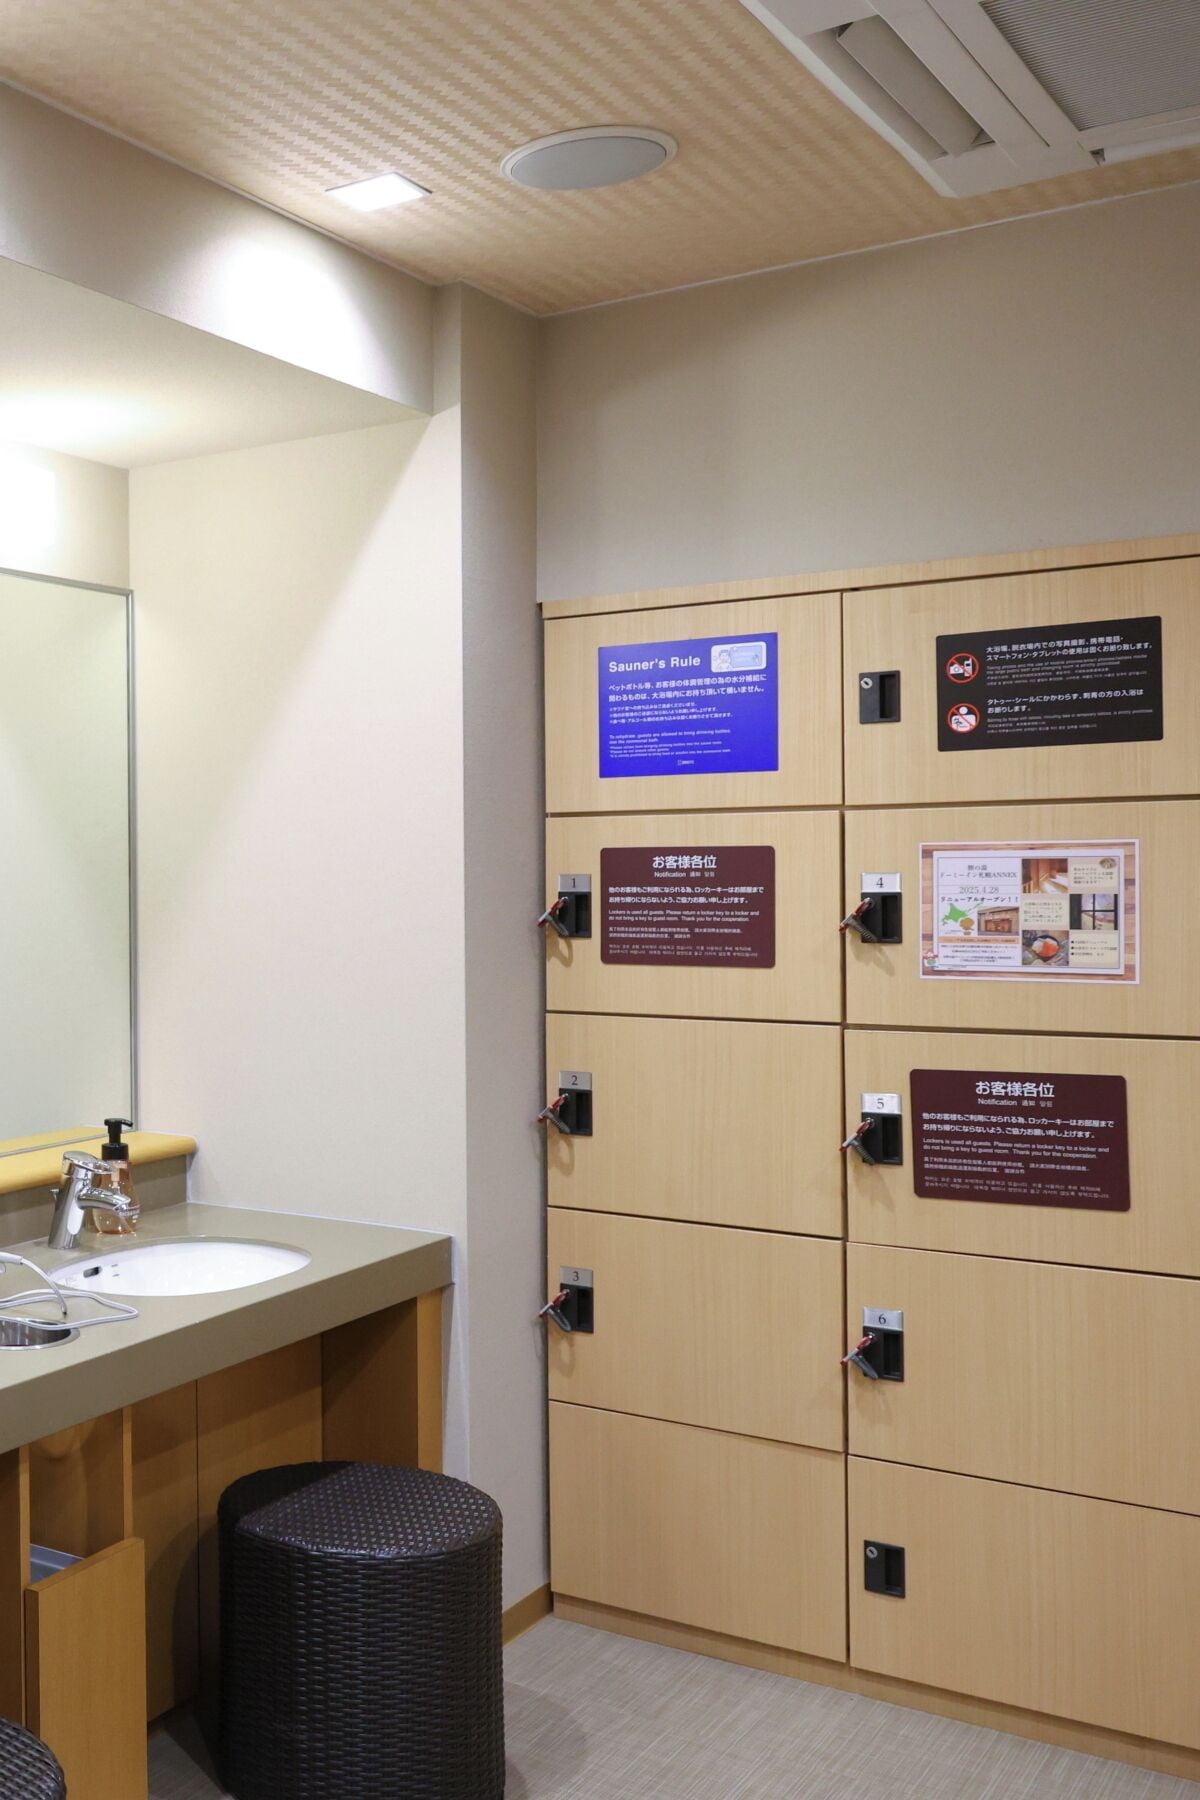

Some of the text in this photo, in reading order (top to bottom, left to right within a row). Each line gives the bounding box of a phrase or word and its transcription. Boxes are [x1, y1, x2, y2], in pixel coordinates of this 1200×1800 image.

[608, 655, 701, 672] Sauner's Rule
[652, 855, 717, 869] お客様各位
[571, 877, 576, 889] 1
[876, 877, 884, 888] 4
[571, 1075, 578, 1086] 2
[976, 1081, 1055, 1097] お客様各位
[876, 1098, 884, 1109] 5
[978, 1098, 1017, 1107] Notification
[572, 1271, 579, 1281] 3
[878, 1313, 886, 1325] 6
